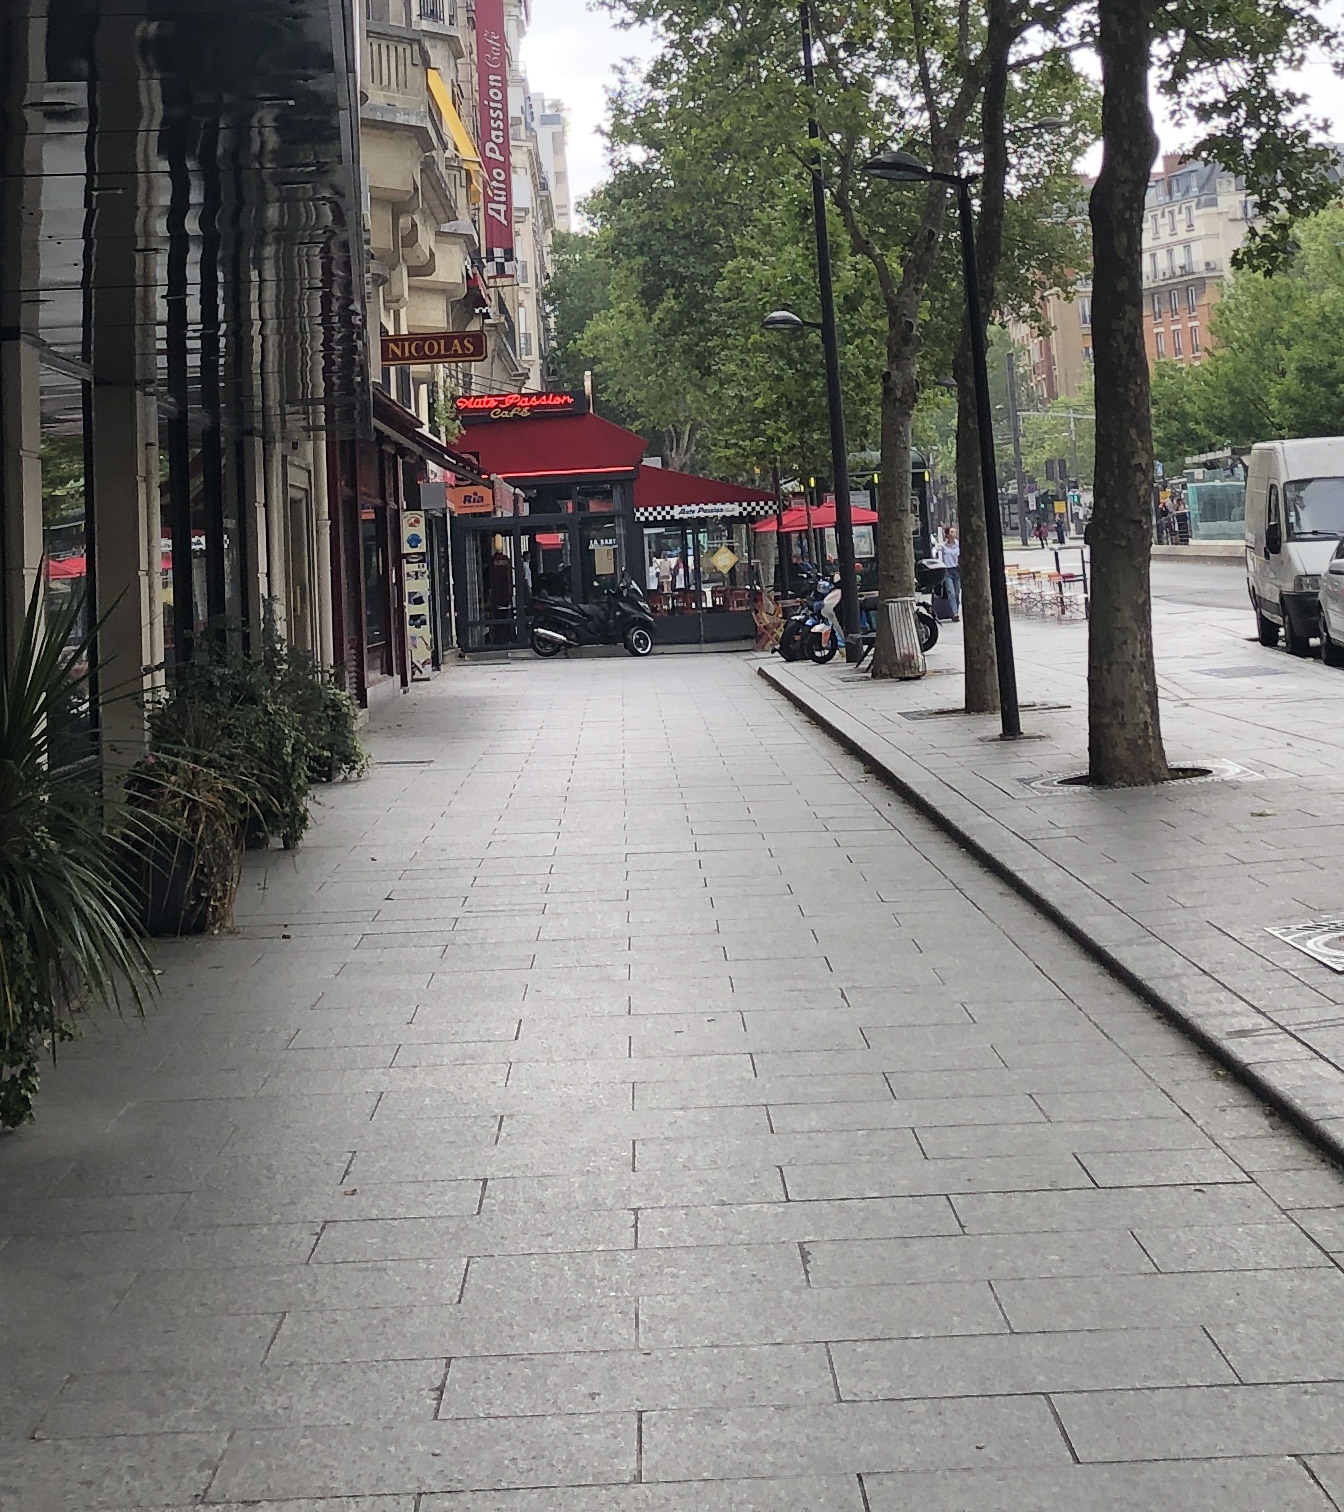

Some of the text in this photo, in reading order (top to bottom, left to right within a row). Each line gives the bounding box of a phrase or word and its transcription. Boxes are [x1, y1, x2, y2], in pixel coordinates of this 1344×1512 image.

[483, 74, 505, 163] Passion
[487, 167, 508, 227] Auto
[387, 337, 475, 359] NICOLAS
[456, 393, 575, 410] Auto Passion
[462, 491, 484, 505] Ria
